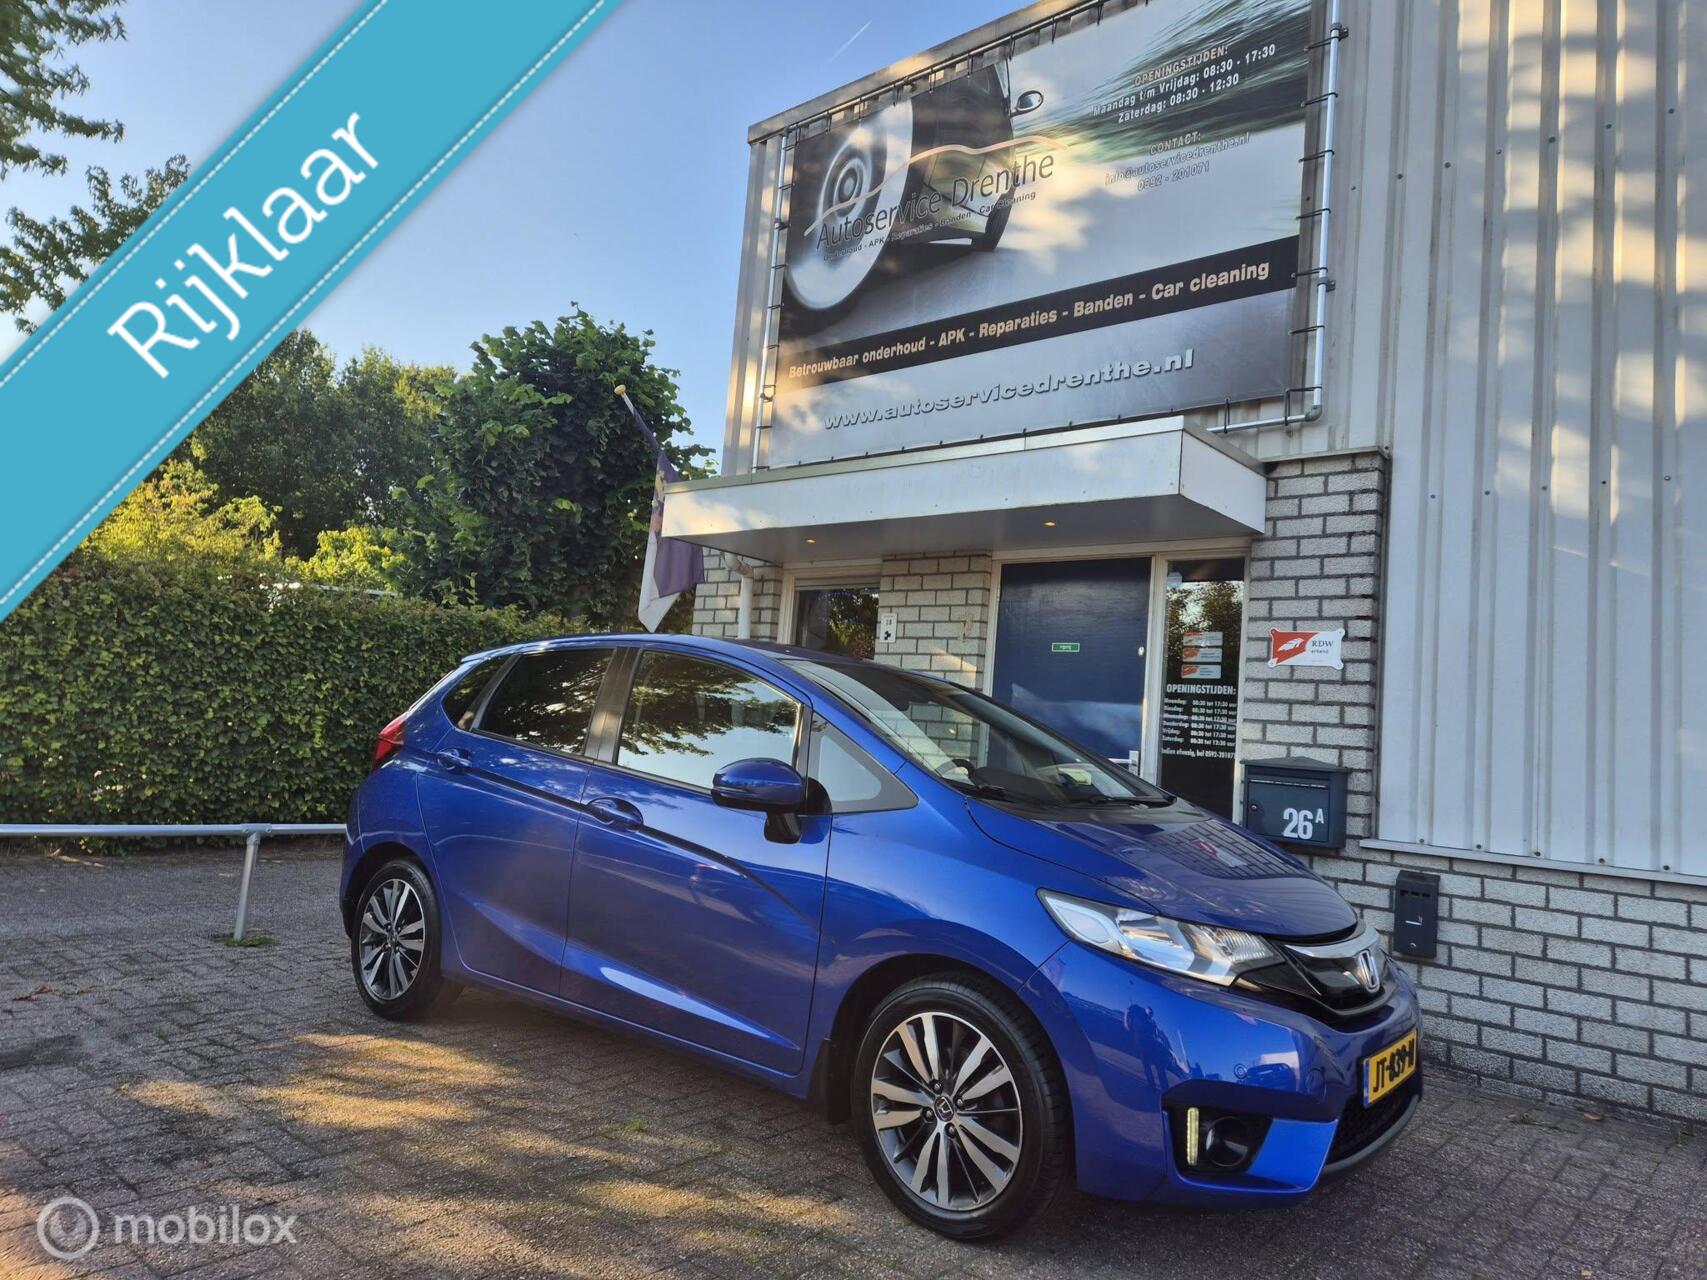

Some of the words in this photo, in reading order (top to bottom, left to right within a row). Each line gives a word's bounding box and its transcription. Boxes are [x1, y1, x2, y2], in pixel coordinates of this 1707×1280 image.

[1092, 94, 1136, 116] Maandag
[1159, 73, 1200, 94] Vrijdag:
[1203, 61, 1233, 79] 08:30
[1245, 43, 1276, 63] 17:30
[1134, 45, 1229, 87] OPENINGSTIJDEN:
[1118, 101, 1167, 124] Zaterdag:
[1170, 88, 1199, 106] 08:30
[1210, 73, 1240, 93] 12:30
[1150, 132, 1201, 155] CONTACT:
[817, 192, 943, 250] Autoservice
[951, 153, 1055, 208] Drenthe
[868, 238, 886, 249] APK
[788, 353, 859, 379] Betrouwbaar
[862, 336, 926, 364] onderhoud
[938, 327, 966, 347] APK
[978, 307, 1058, 339] Reparaties
[1073, 291, 1134, 318] Banden
[1151, 280, 1184, 301] Car
[1189, 262, 1271, 293] cleaning
[823, 348, 1195, 431] www.autoservicedrenthe.nl
[1166, 684, 1237, 695] OPENINGSTIJDEN:
